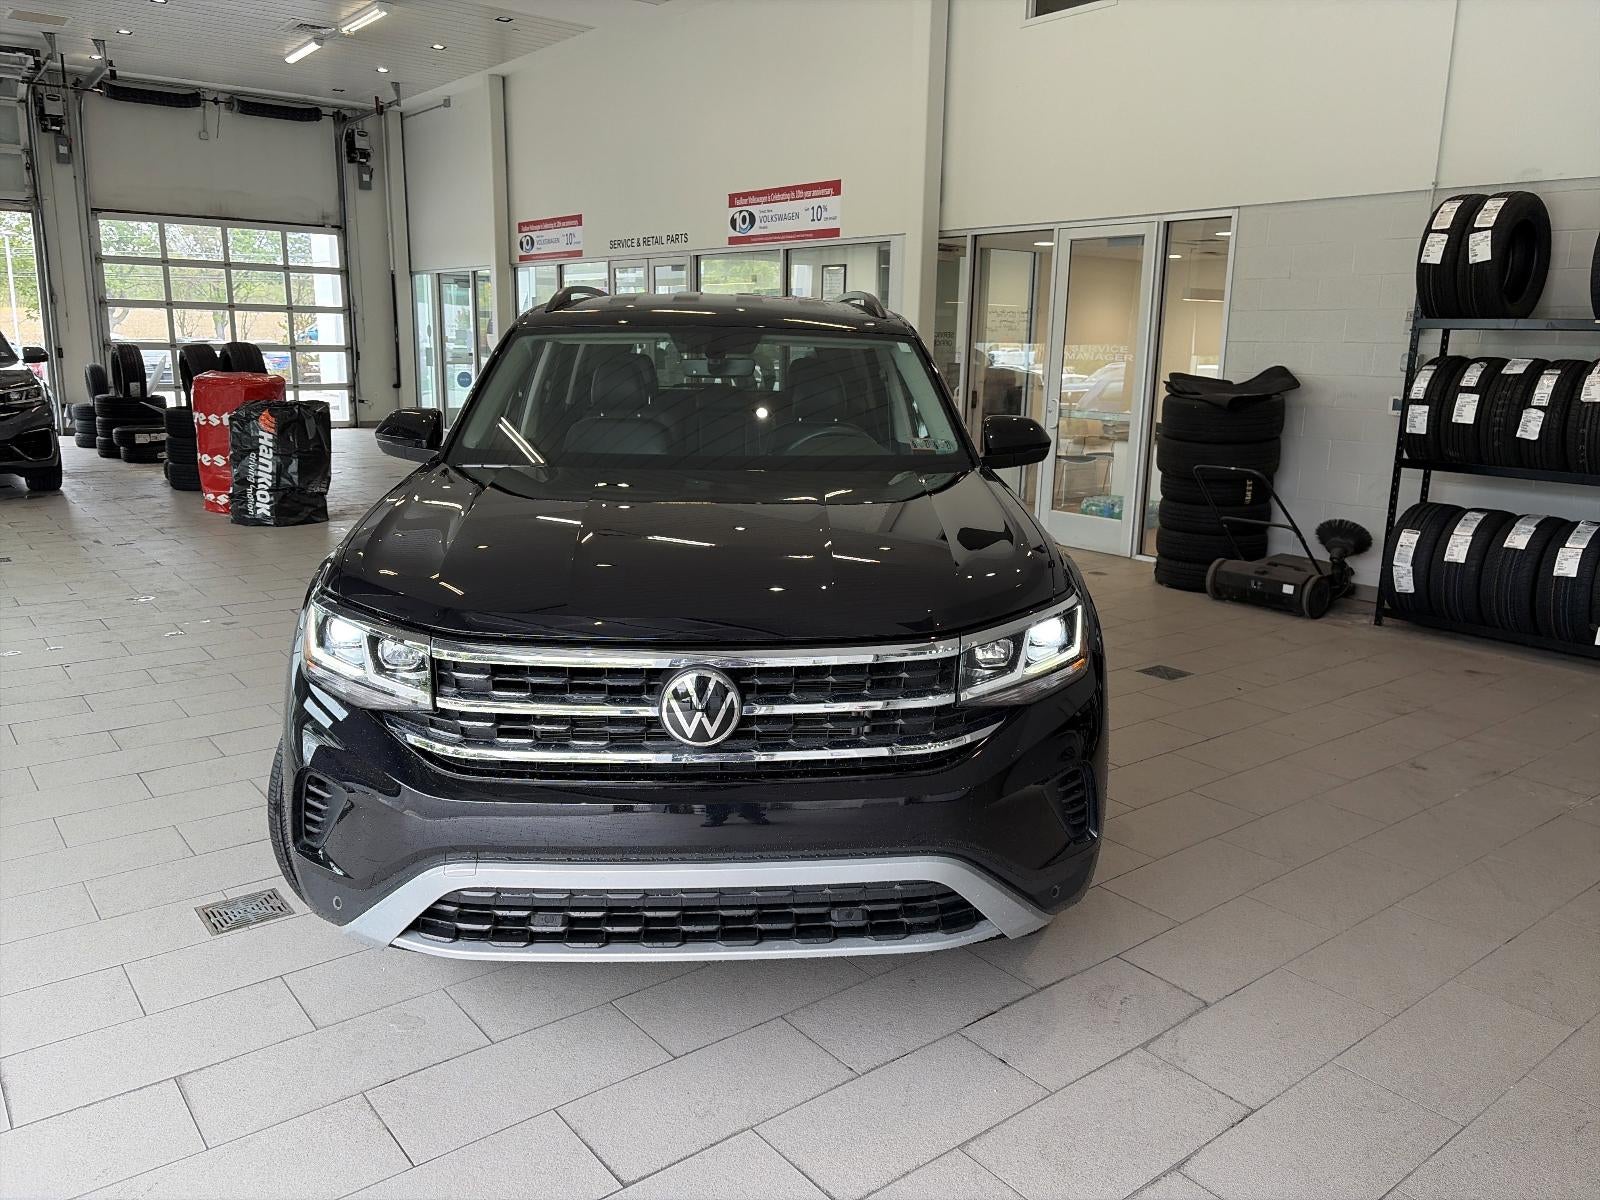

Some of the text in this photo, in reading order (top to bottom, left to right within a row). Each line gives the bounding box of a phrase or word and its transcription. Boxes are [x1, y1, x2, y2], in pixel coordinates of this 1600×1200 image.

[733, 210, 750, 232] 10
[759, 212, 800, 223] VOLKSWAGEN
[609, 233, 688, 249] SERVICE & RETAIL PARTS
[1071, 344, 1129, 353] SERVICE
[1065, 351, 1134, 362] MANAGER
[246, 452, 257, 483] driving
